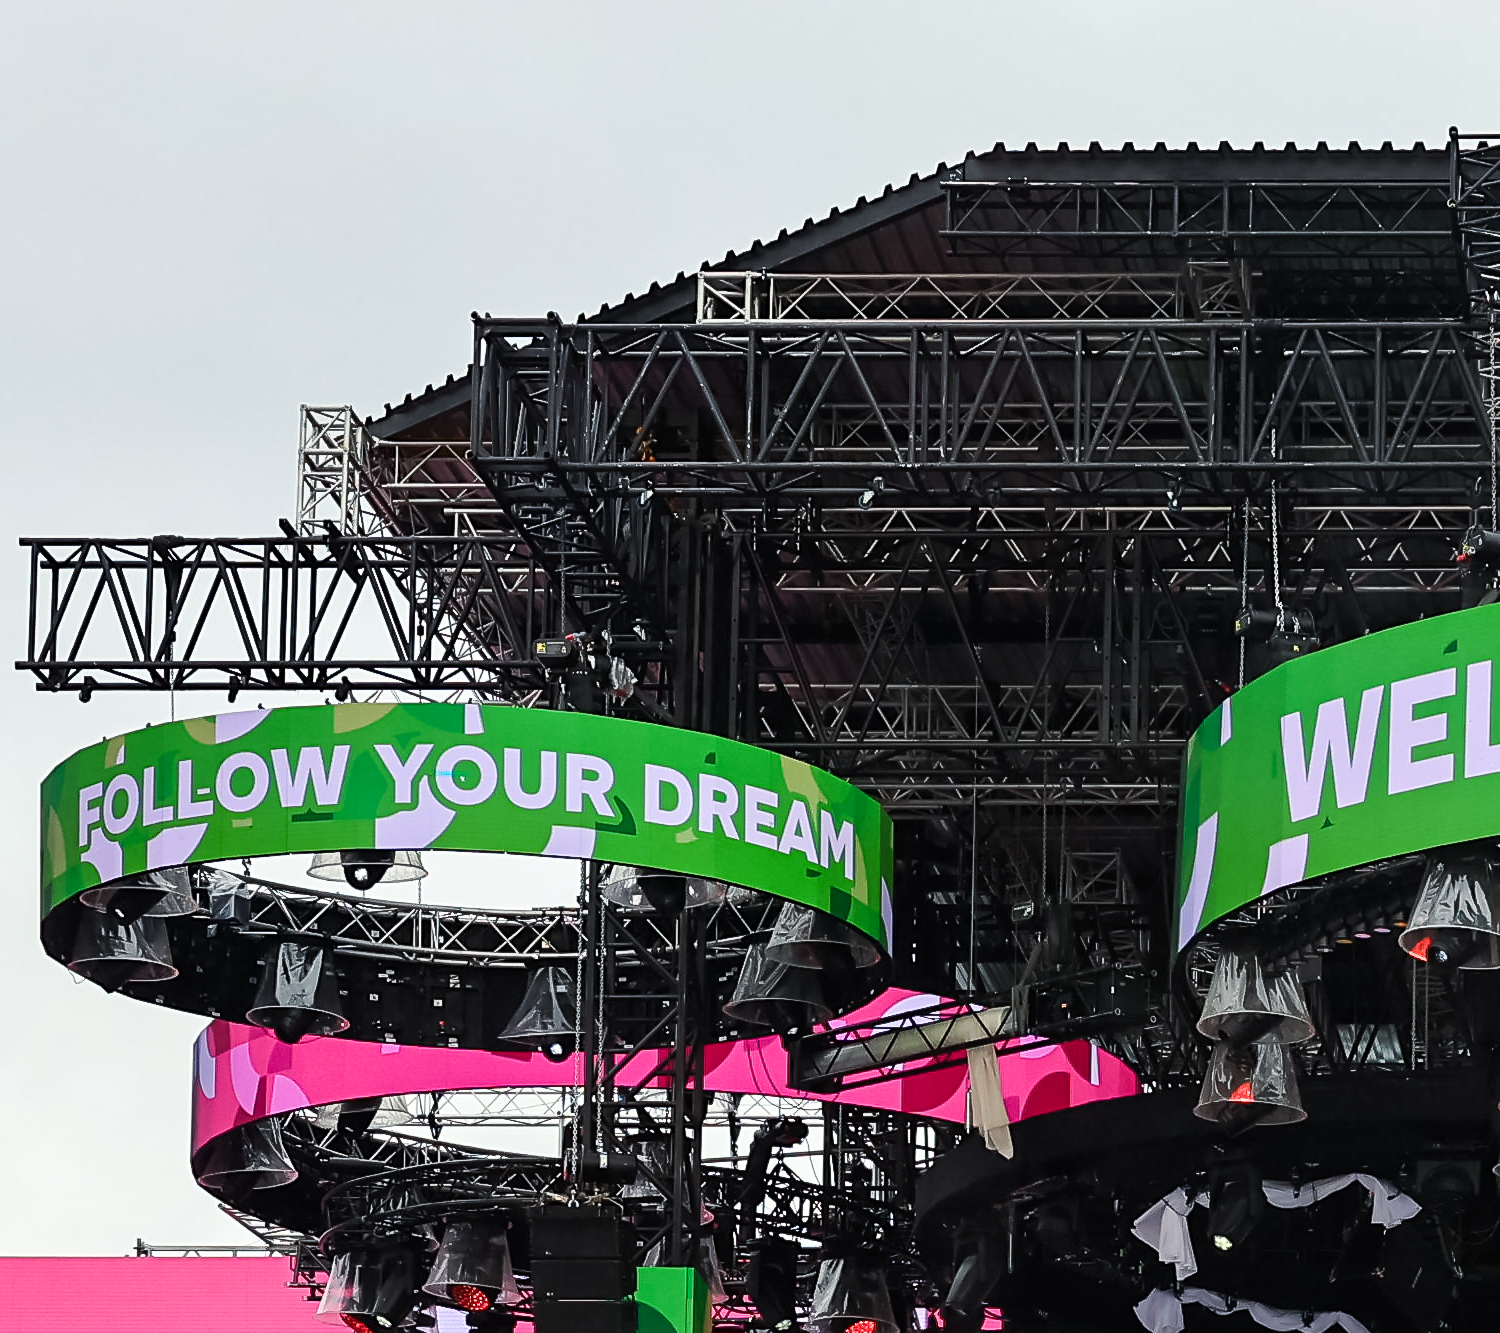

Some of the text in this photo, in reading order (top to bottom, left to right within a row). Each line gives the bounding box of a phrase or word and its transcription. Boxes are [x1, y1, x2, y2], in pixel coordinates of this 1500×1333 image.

[78, 744, 856, 881] FOLLOW YOUR DREAM
